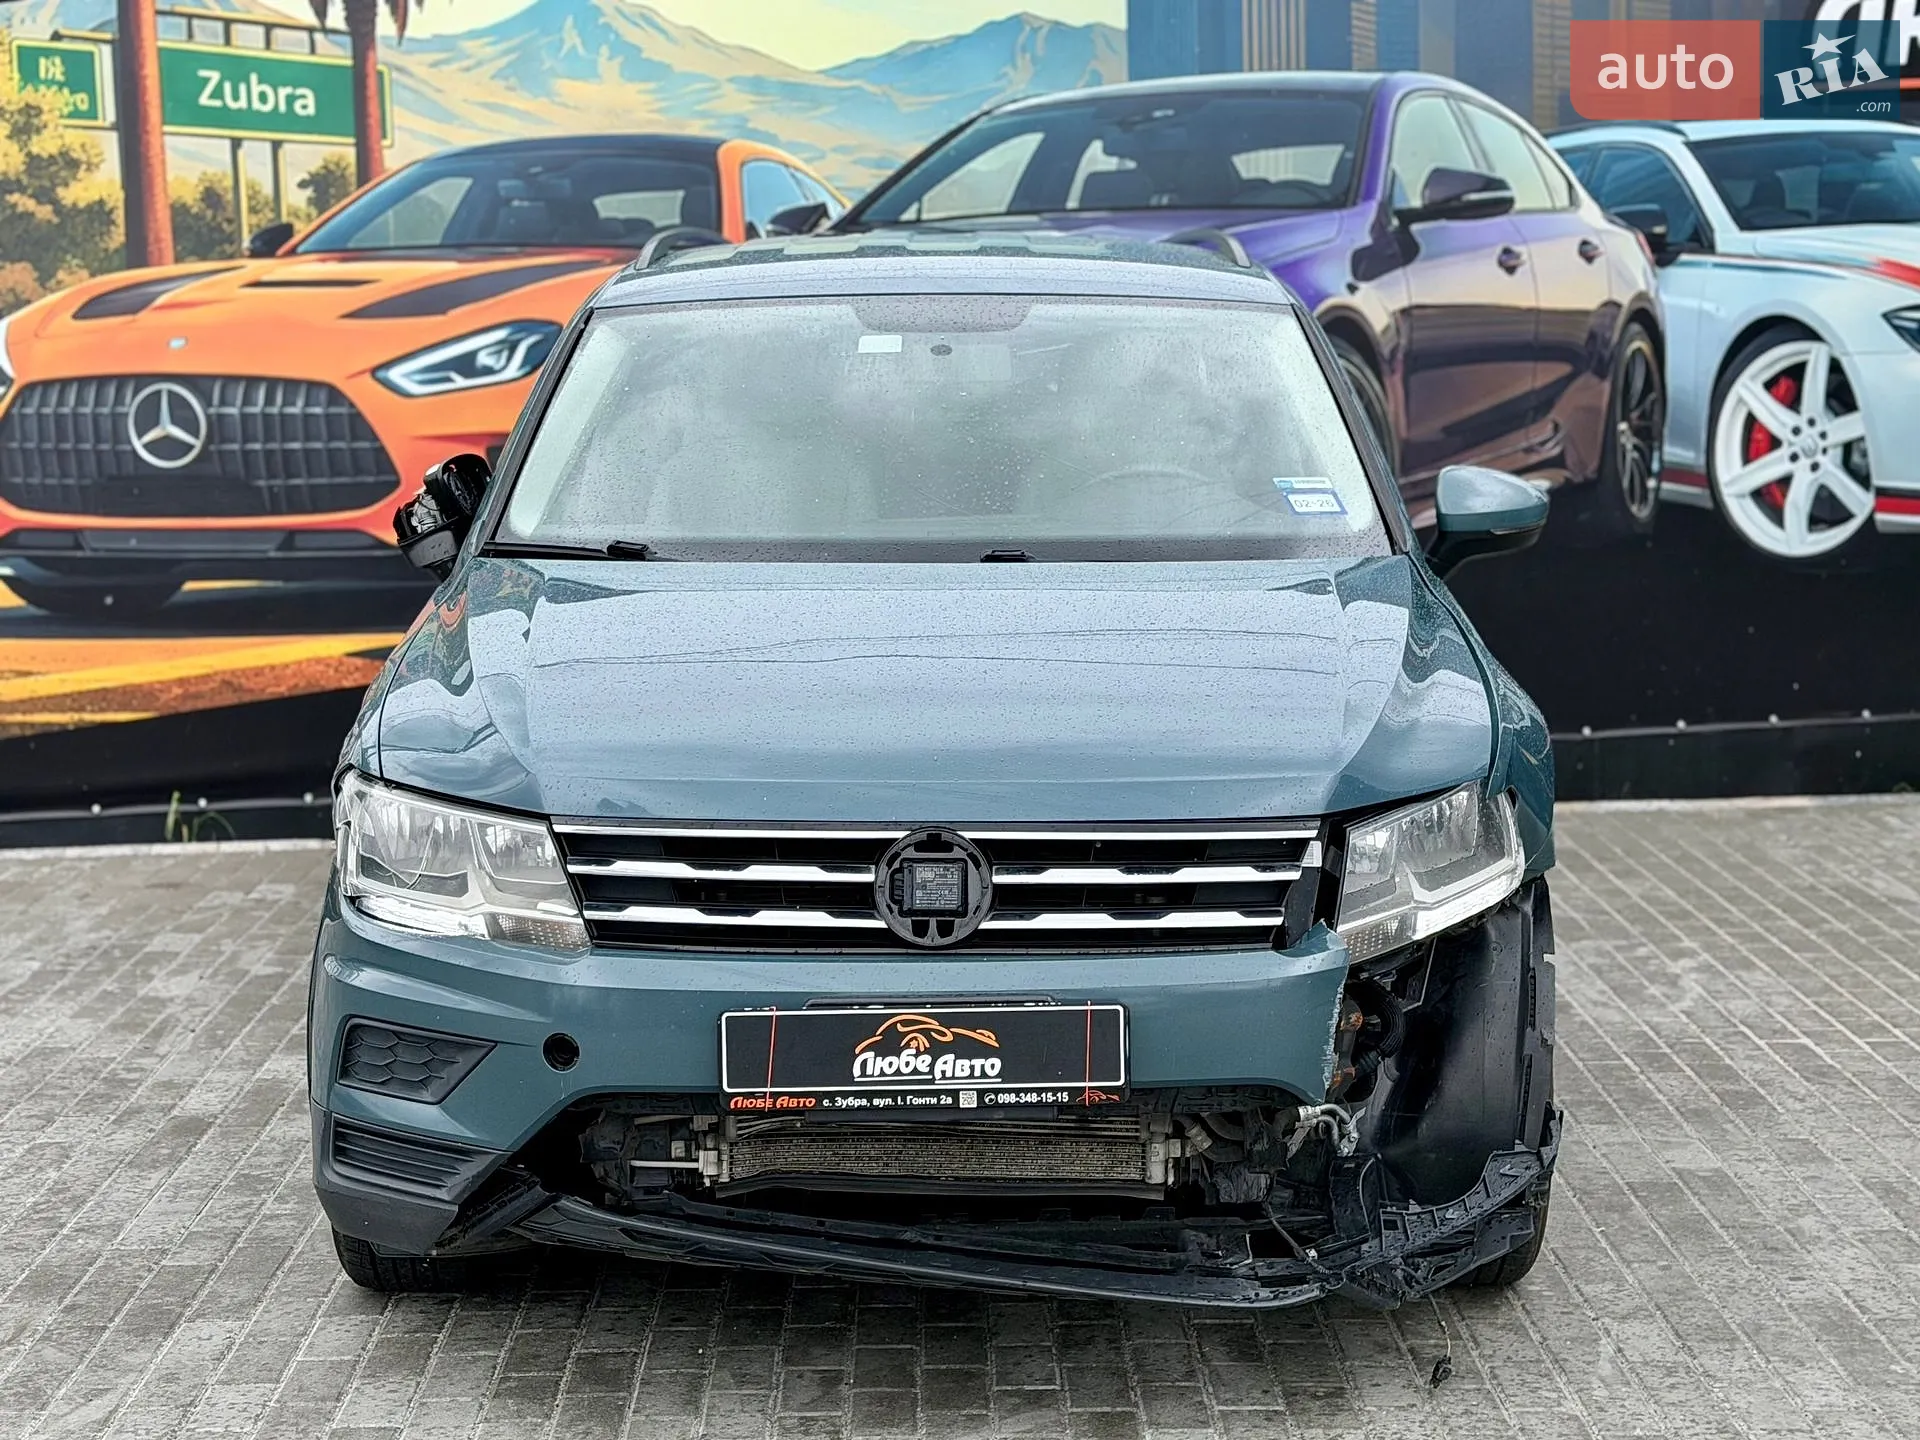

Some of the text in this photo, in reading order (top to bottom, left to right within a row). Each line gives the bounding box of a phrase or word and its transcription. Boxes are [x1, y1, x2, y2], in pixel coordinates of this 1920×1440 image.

[196, 69, 316, 117] Zubra
[834, 1096, 871, 1109] Зубра,
[872, 1097, 895, 1108] вул.
[906, 1095, 937, 1106] Гонти
[939, 1094, 953, 1105] 2а
[997, 1091, 1069, 1105] 098-348-15-15
